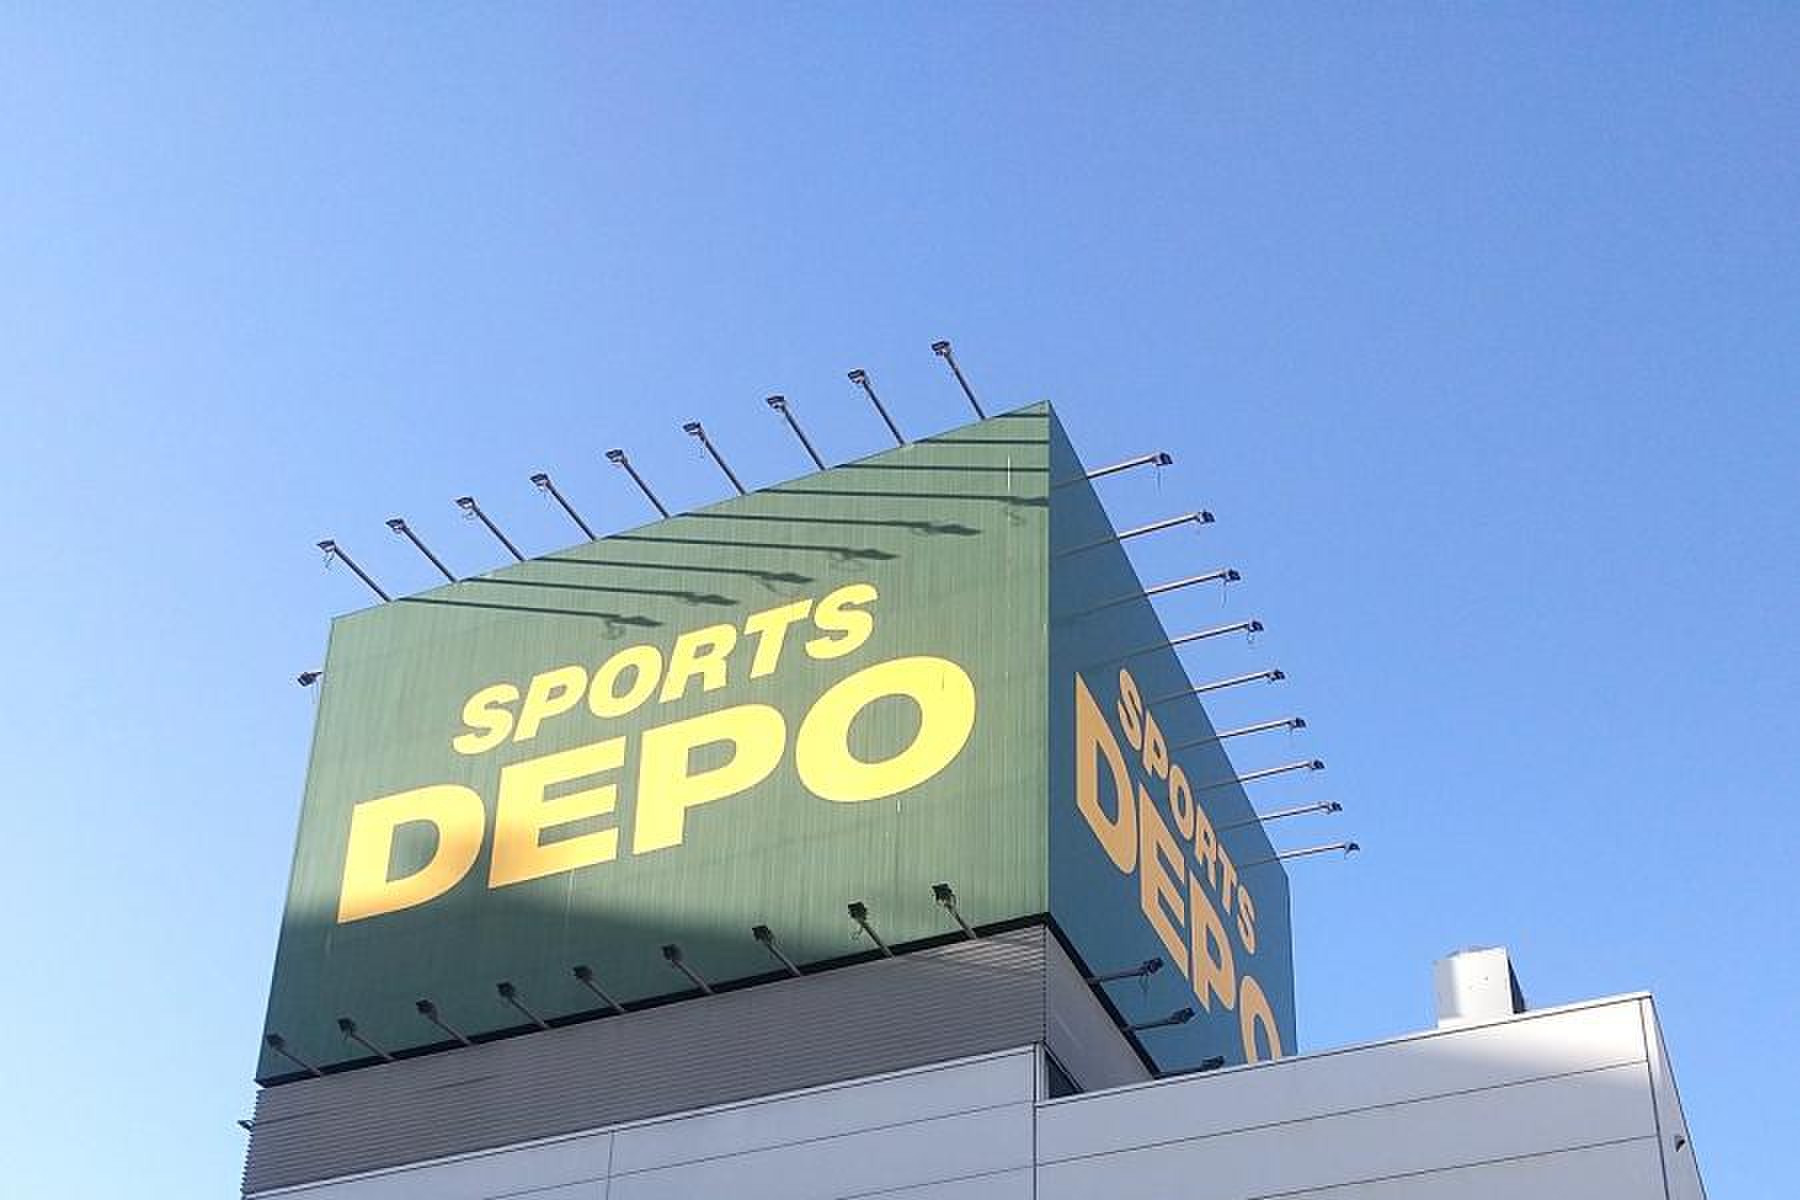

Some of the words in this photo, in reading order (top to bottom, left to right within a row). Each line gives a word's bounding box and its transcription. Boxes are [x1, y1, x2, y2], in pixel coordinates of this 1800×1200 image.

[336, 654, 978, 924] DEPO
[453, 583, 878, 755] SPORTS
[1118, 668, 1256, 956] SPORTS
